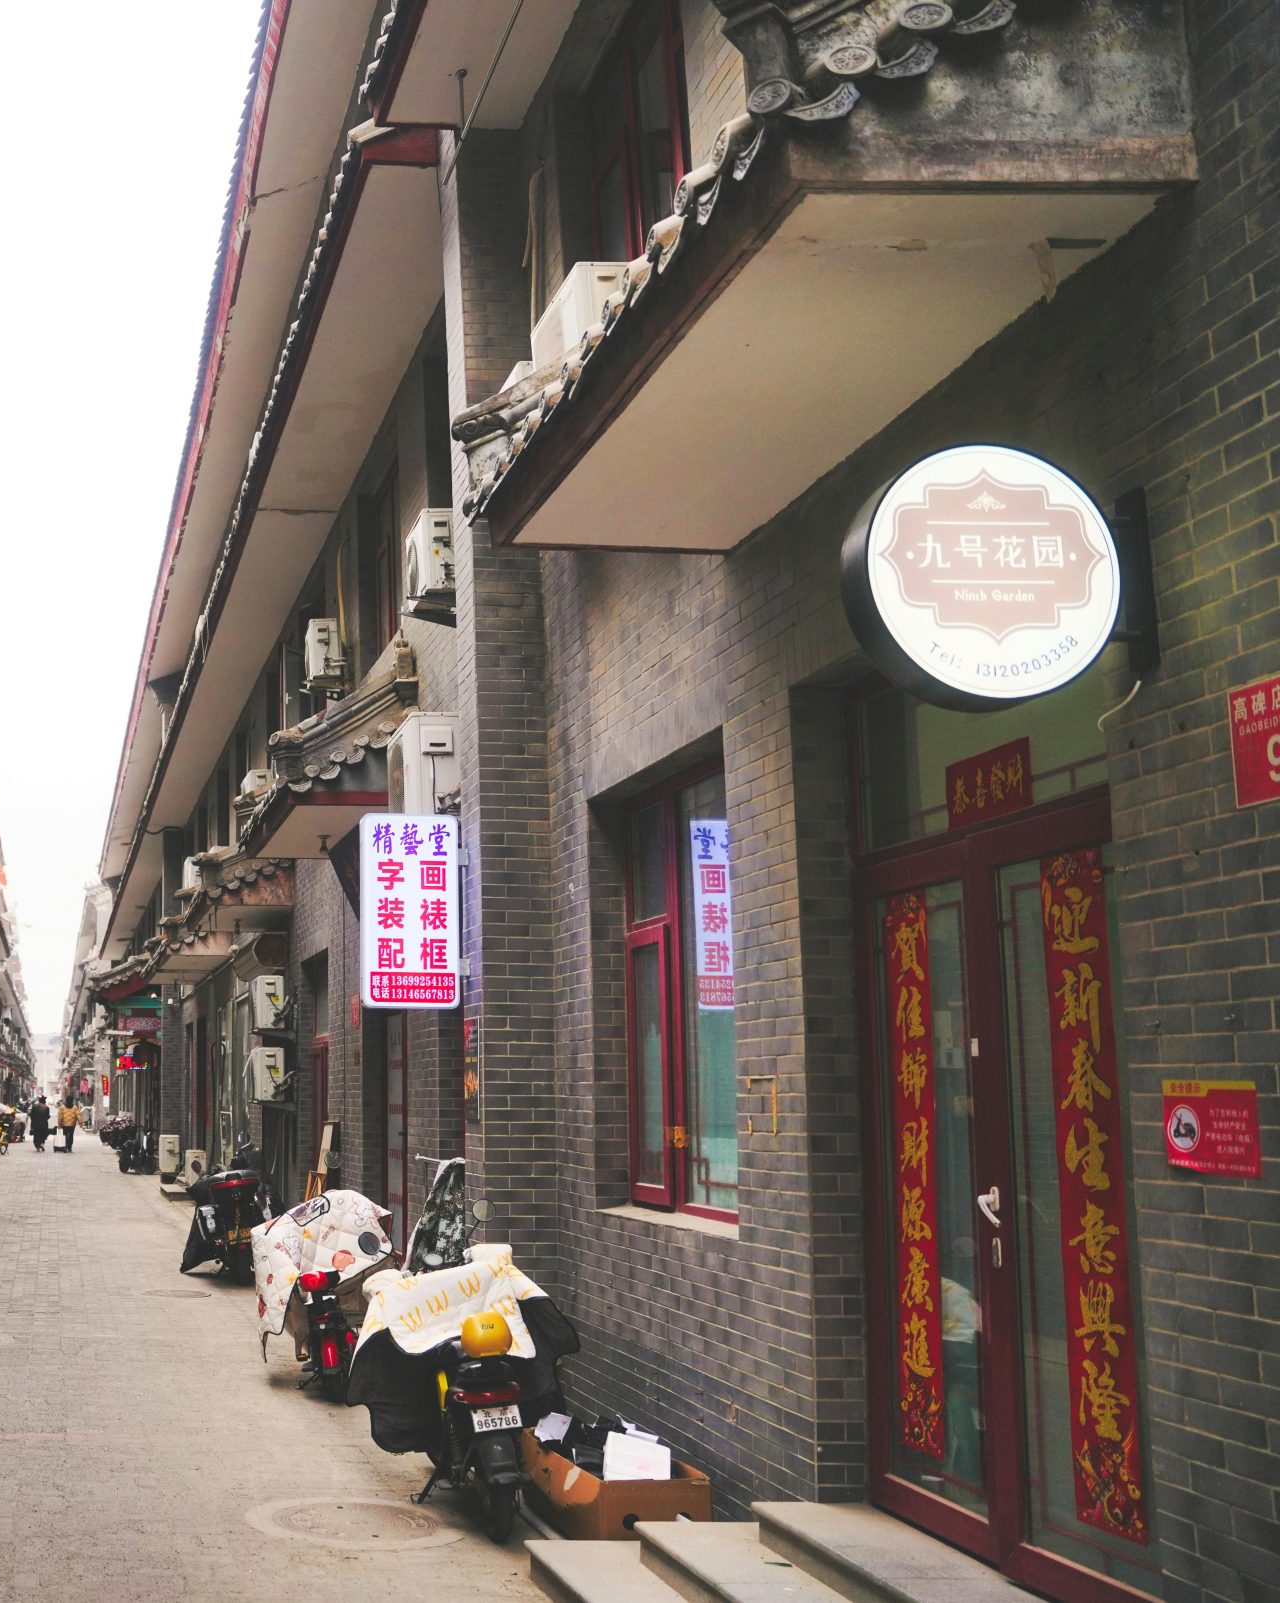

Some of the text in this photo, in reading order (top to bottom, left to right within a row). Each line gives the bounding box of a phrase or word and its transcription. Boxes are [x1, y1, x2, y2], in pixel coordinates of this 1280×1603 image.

[917, 533, 1064, 569] 九号花园
[954, 589, 1035, 602] Ninth Garden
[929, 634, 1079, 677] Tel: 13120203358
[1239, 714, 1280, 737] GAOBEID
[371, 975, 455, 987] 联系 13699254135
[372, 987, 455, 1000] 电话 13146567813
[476, 1415, 519, 1430] 965786
